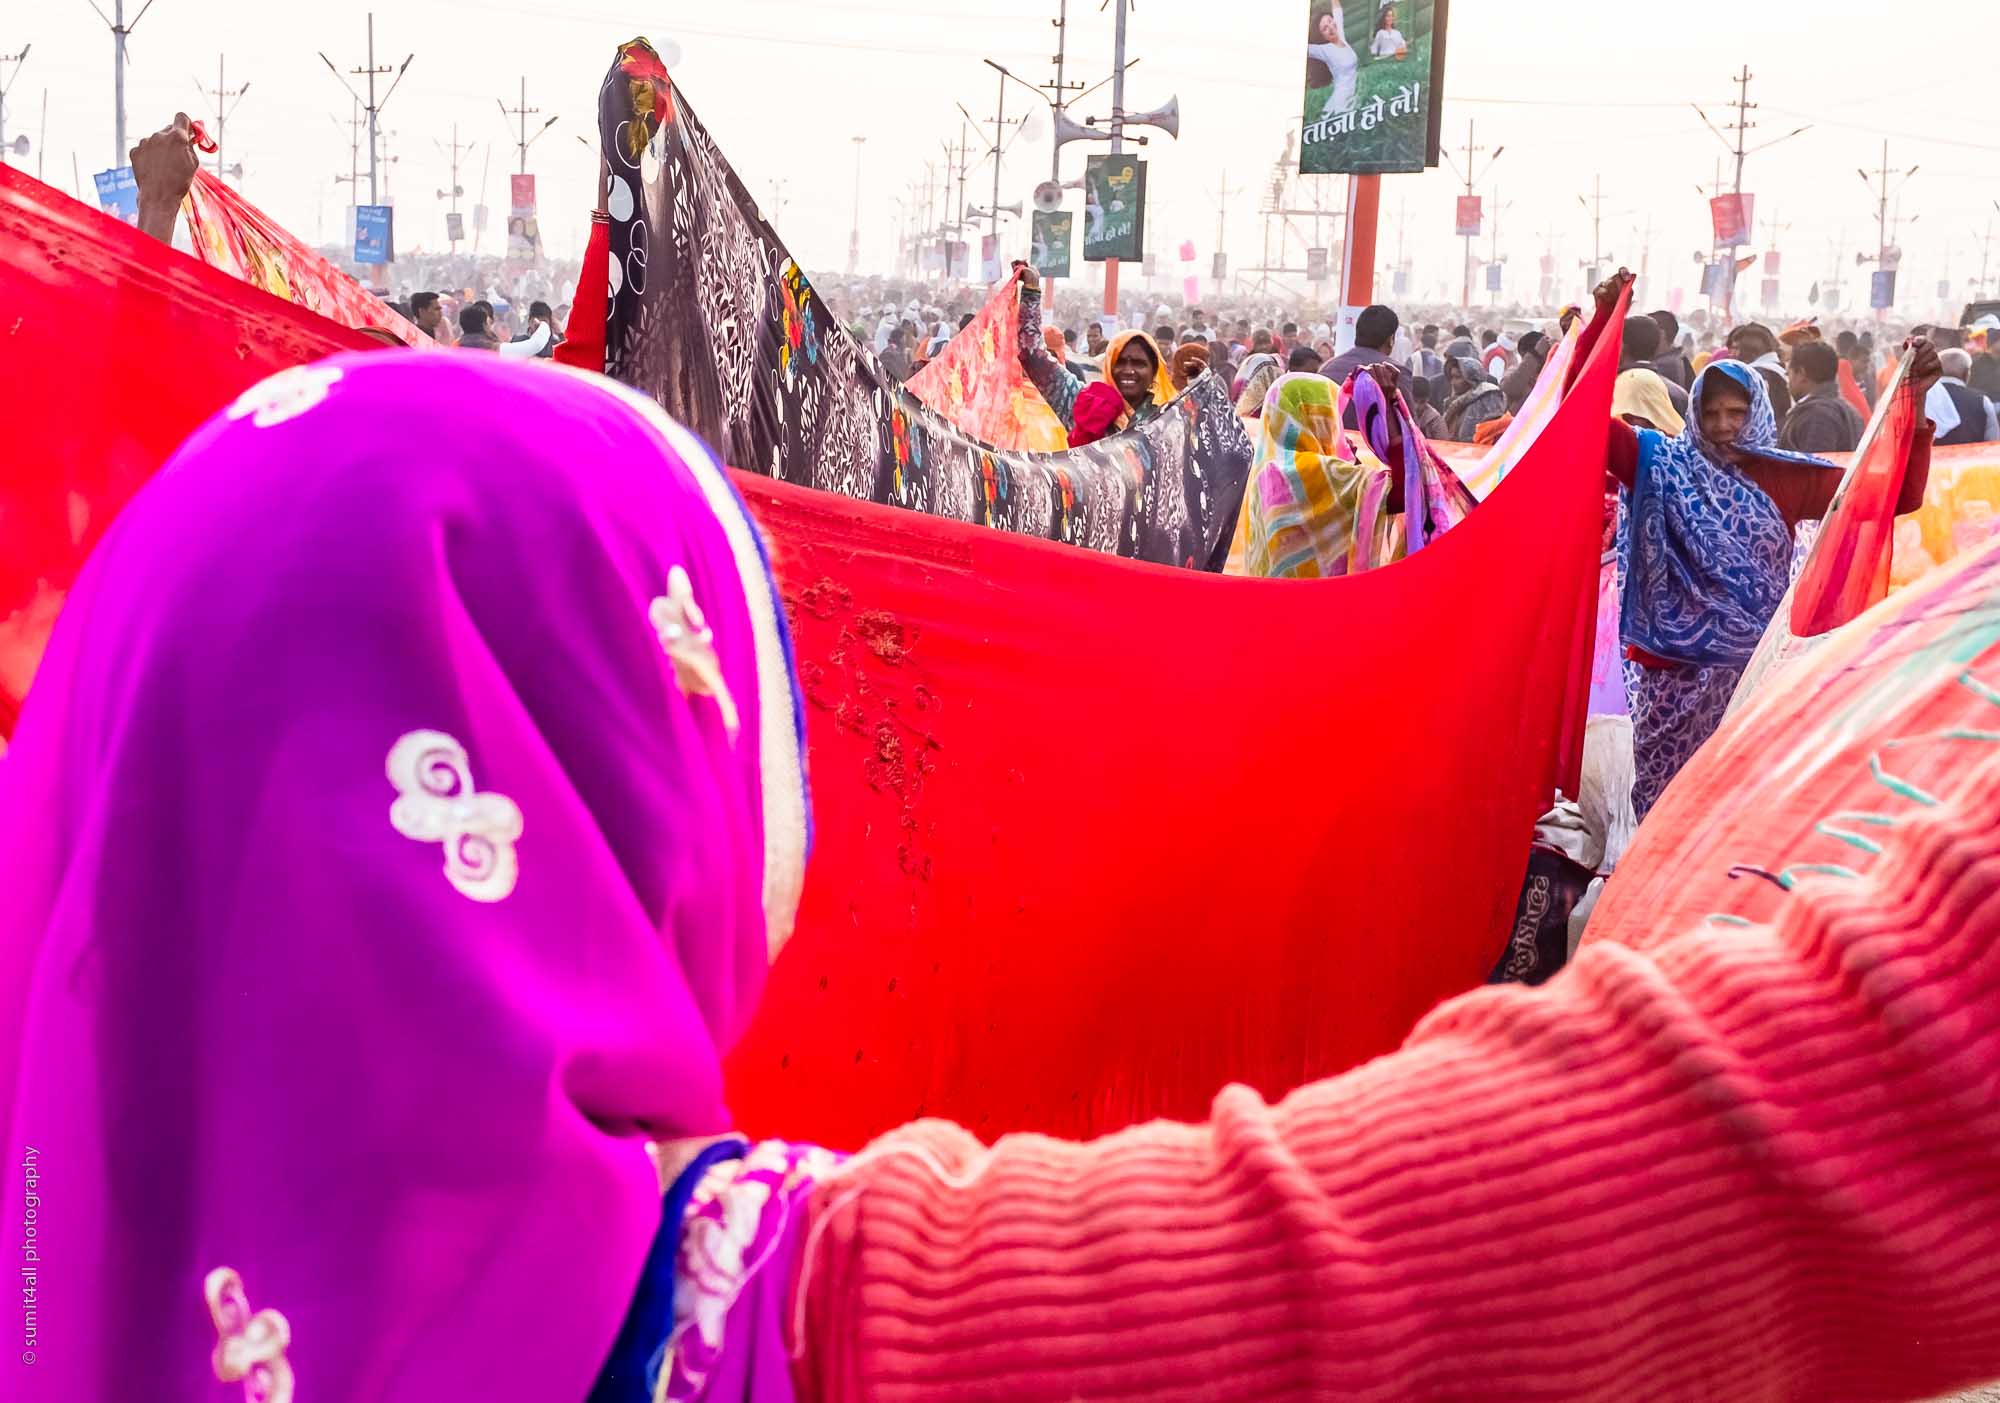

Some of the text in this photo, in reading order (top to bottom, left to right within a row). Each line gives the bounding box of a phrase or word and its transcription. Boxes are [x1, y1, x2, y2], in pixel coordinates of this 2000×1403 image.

[1360, 94, 1386, 131] हो
[1390, 82, 1420, 117] ले!
[1503, 875, 1550, 980] Rajshree
